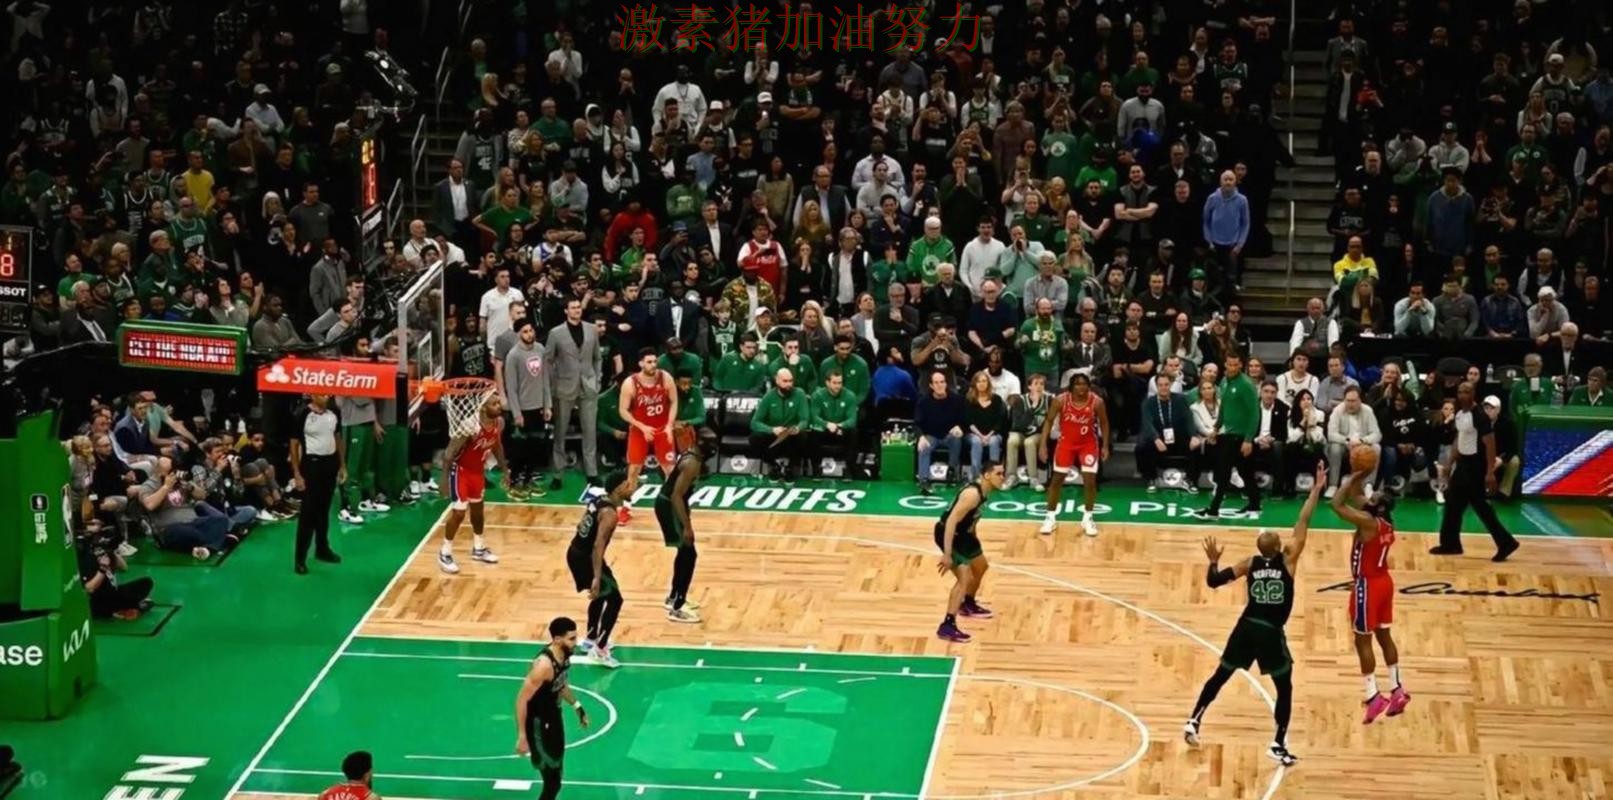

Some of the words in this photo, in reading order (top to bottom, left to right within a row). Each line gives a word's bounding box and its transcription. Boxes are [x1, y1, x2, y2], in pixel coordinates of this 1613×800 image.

[0, 254, 14, 276] 8
[646, 405, 664, 417] 20
[1080, 426, 1089, 435] 0
[630, 484, 866, 512] PAYOFFS
[898, 495, 1112, 516] Gogle
[1250, 580, 1284, 604] 42
[627, 682, 848, 773] 6
